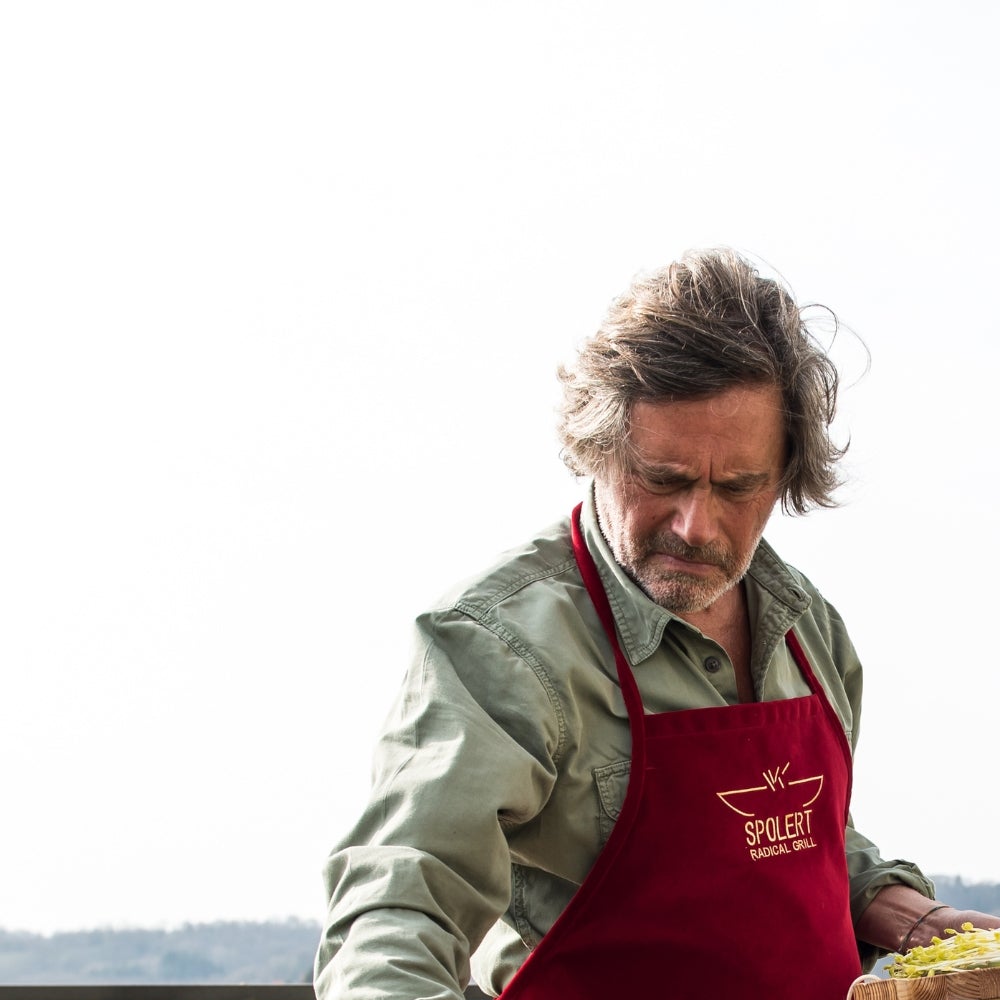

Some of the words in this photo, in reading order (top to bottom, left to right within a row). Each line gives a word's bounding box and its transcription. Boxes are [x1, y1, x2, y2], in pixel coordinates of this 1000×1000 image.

[744, 810, 813, 846] SPOLERT
[750, 843, 791, 861] RADICAL
[792, 837, 817, 851] GRILL
